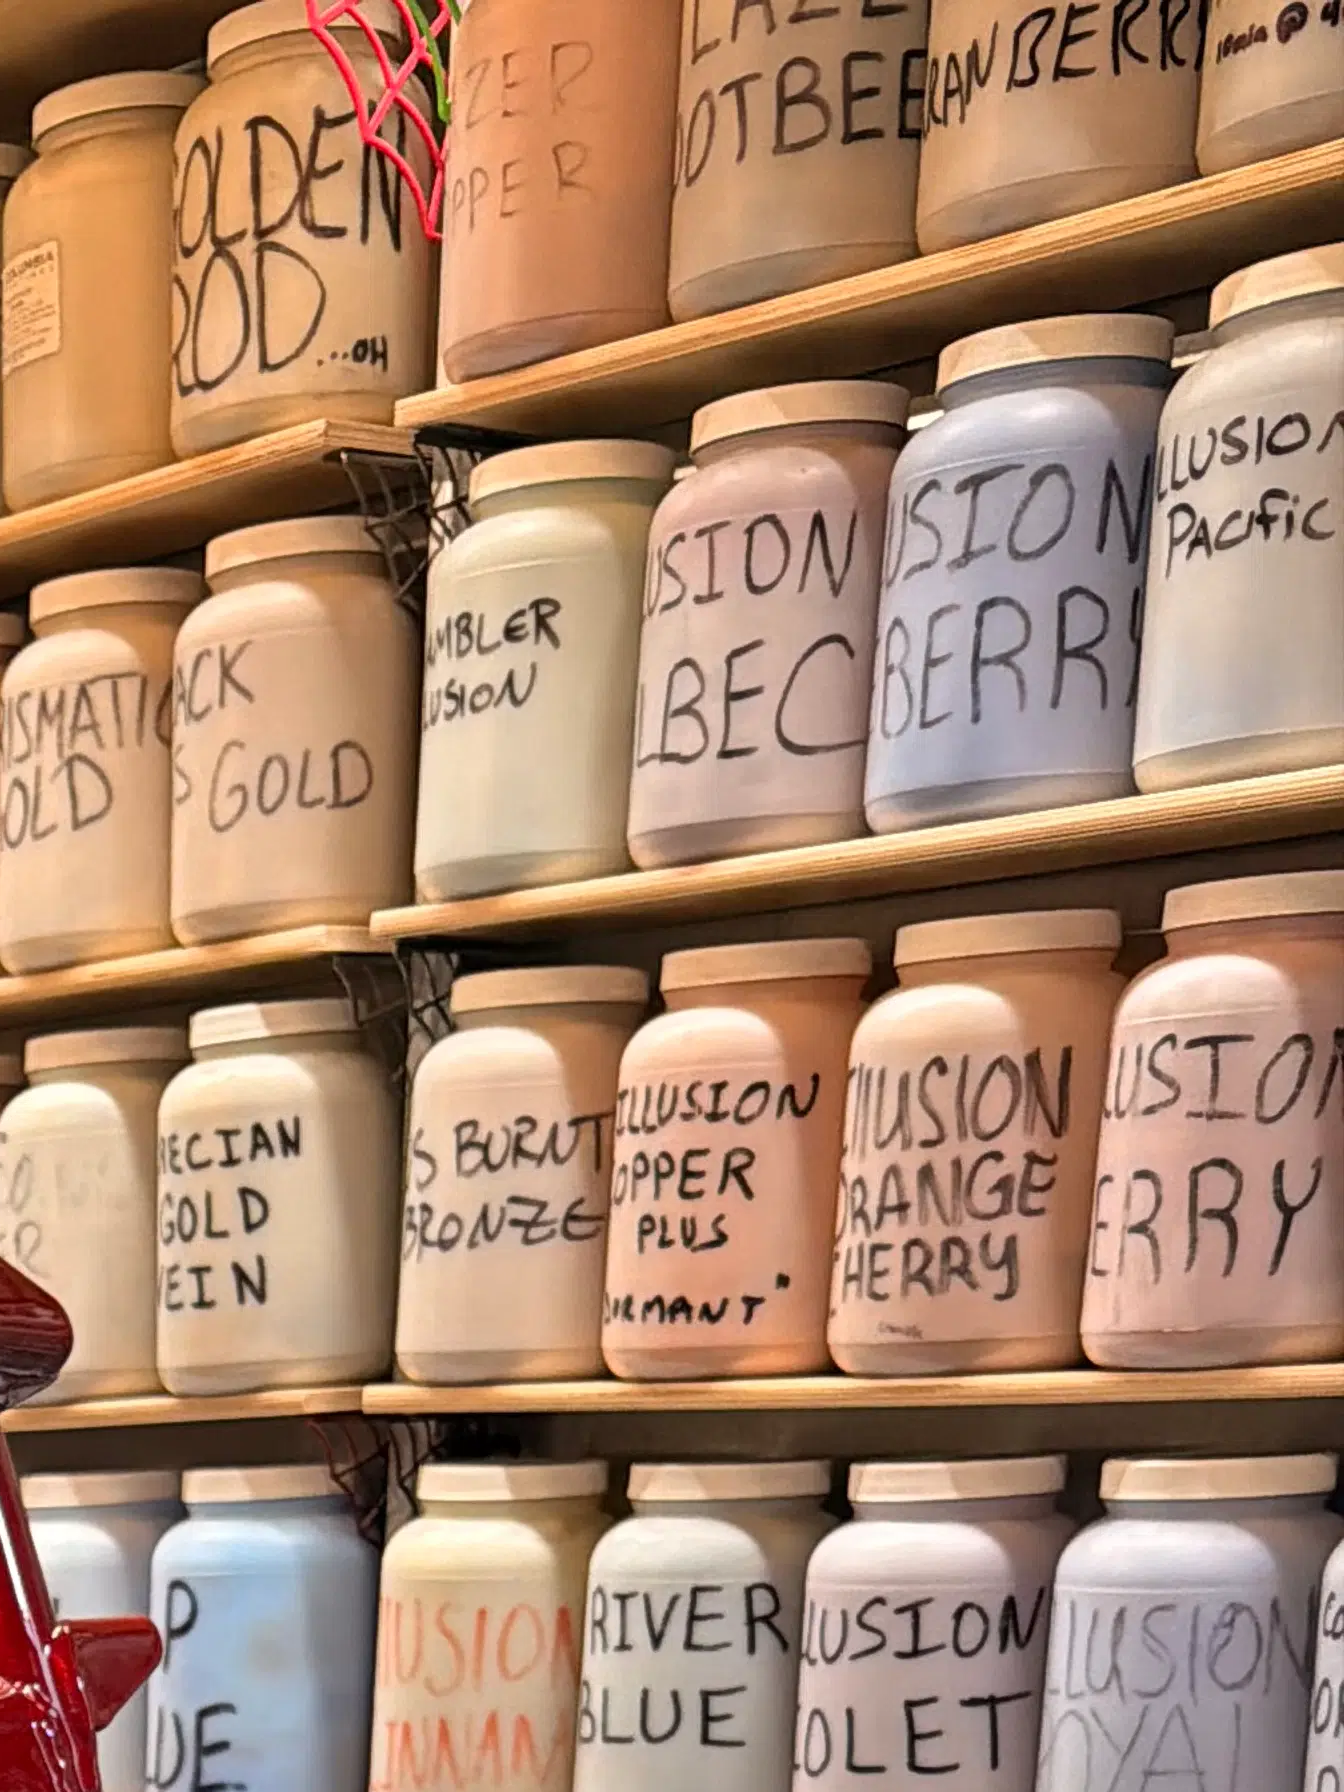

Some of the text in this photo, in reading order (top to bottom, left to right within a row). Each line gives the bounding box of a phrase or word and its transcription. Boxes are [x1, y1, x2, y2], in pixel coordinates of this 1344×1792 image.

[173, 98, 406, 260] OLDEN
[208, 740, 376, 833] GOLD
[454, 1110, 612, 1178] BURNT
[636, 1212, 730, 1256] PLUS
[590, 1581, 790, 1657] RIVER
[578, 1679, 748, 1748] BLUE
[793, 1691, 1033, 1778] OLET
